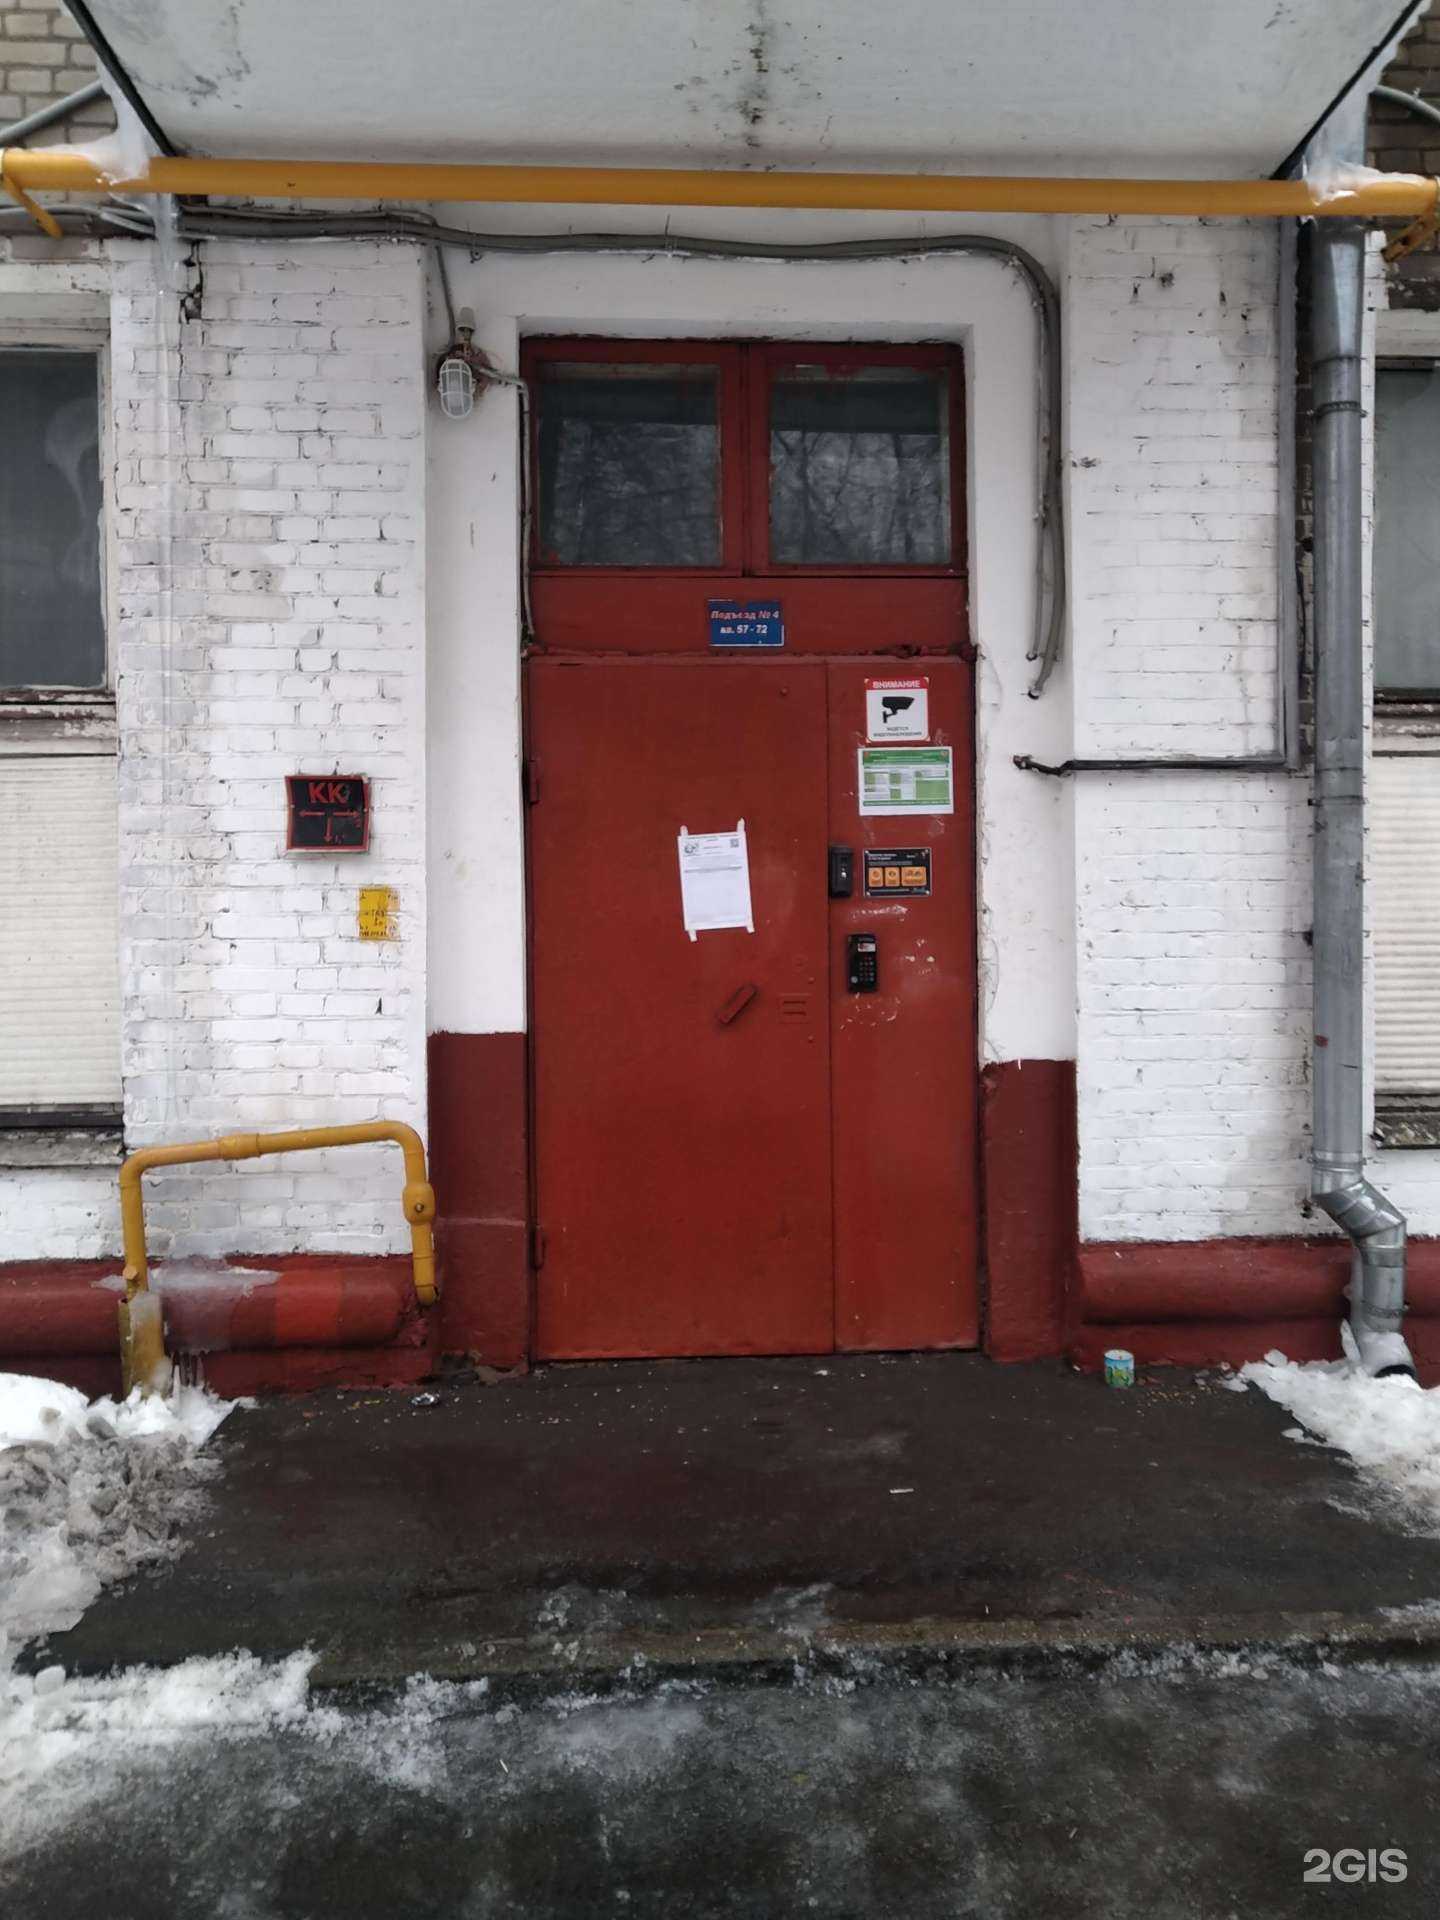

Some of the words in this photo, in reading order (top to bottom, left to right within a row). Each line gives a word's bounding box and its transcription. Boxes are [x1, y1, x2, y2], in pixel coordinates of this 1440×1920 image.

[710, 610, 757, 620] Подъезд
[755, 624, 768, 634] 72
[872, 679, 921, 689] ВНИМАНИЕ
